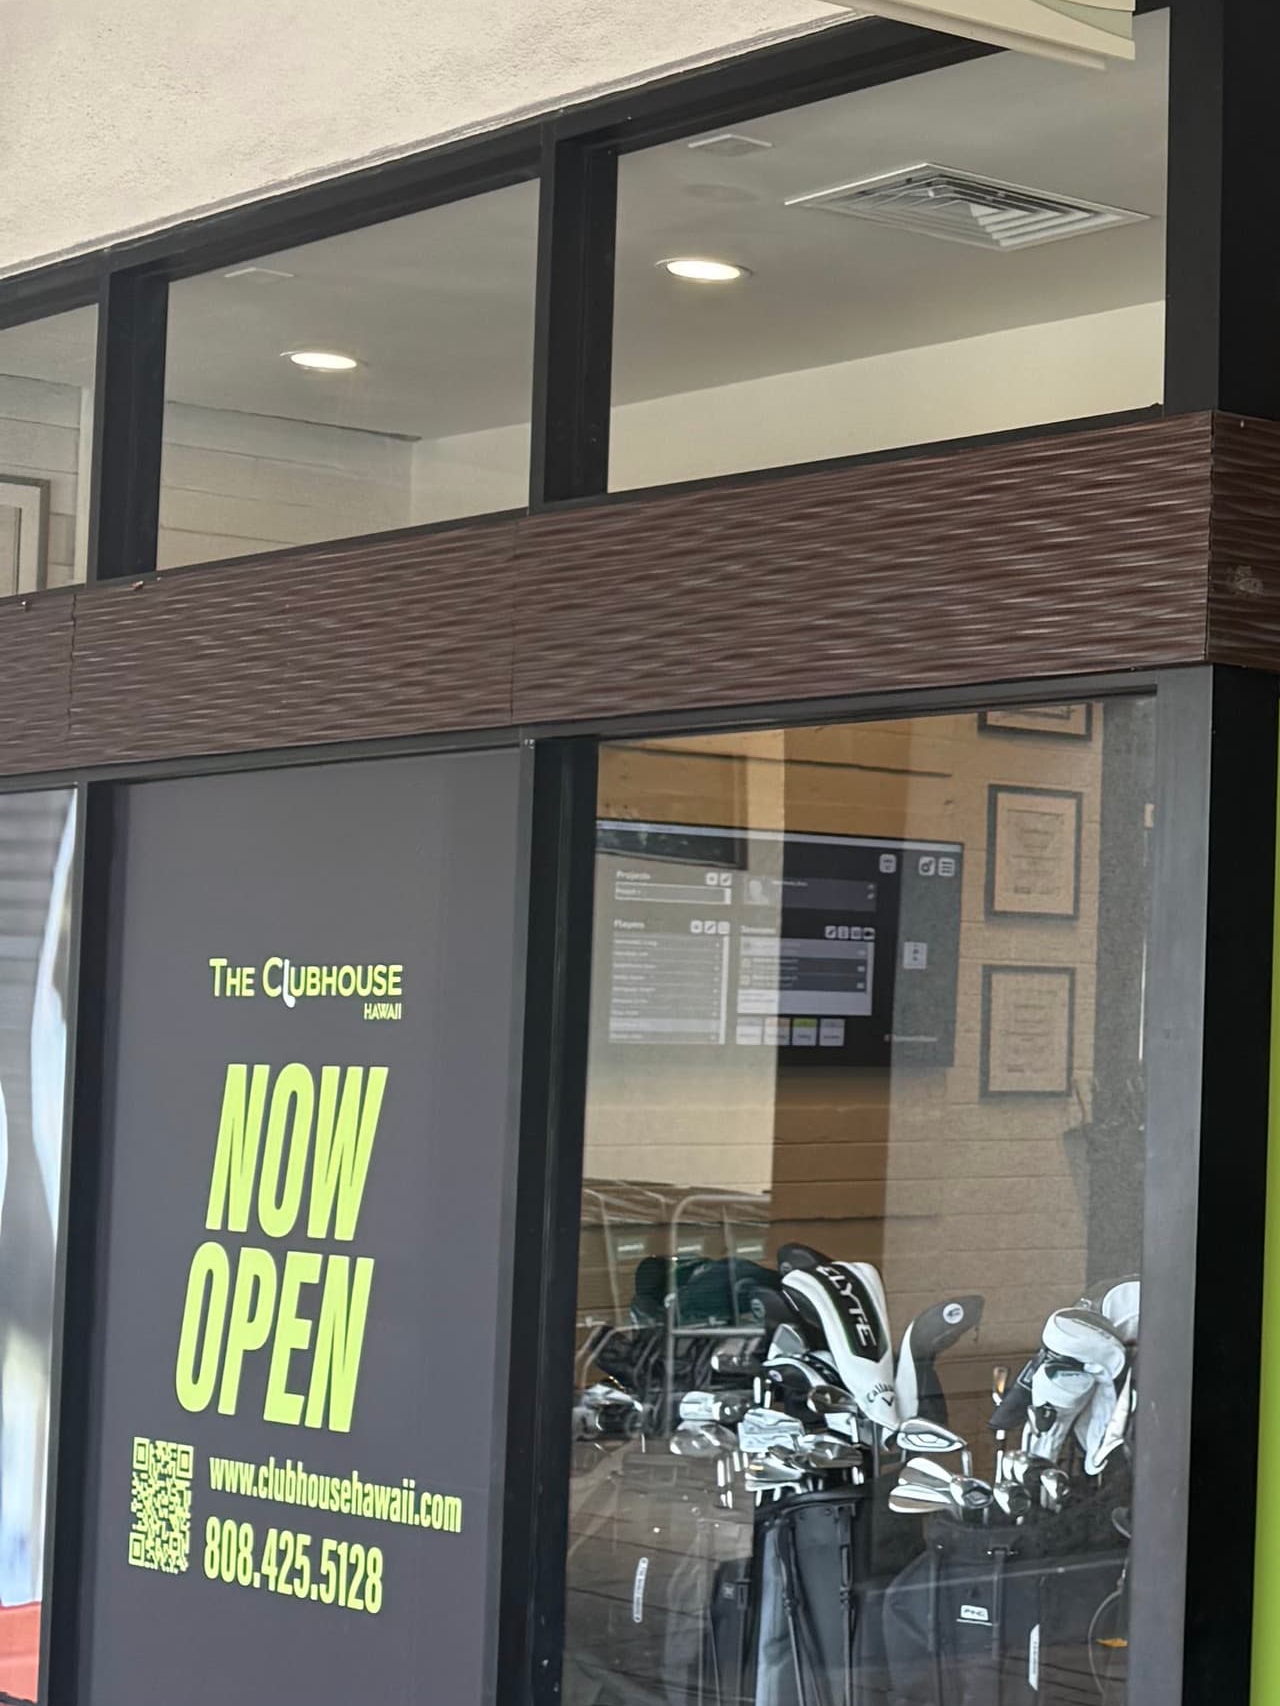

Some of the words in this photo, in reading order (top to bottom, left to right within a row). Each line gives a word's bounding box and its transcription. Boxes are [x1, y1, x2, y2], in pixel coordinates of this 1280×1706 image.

[209, 958, 255, 997] THE
[262, 957, 403, 1008] CLUBHOUSE
[364, 1002, 402, 1020] HAWAII
[206, 1062, 389, 1242] NOW
[175, 1242, 376, 1434] OPEN
[208, 1455, 463, 1534] www.clubhousehawaii.com
[204, 1516, 384, 1614] 808.425.5128
